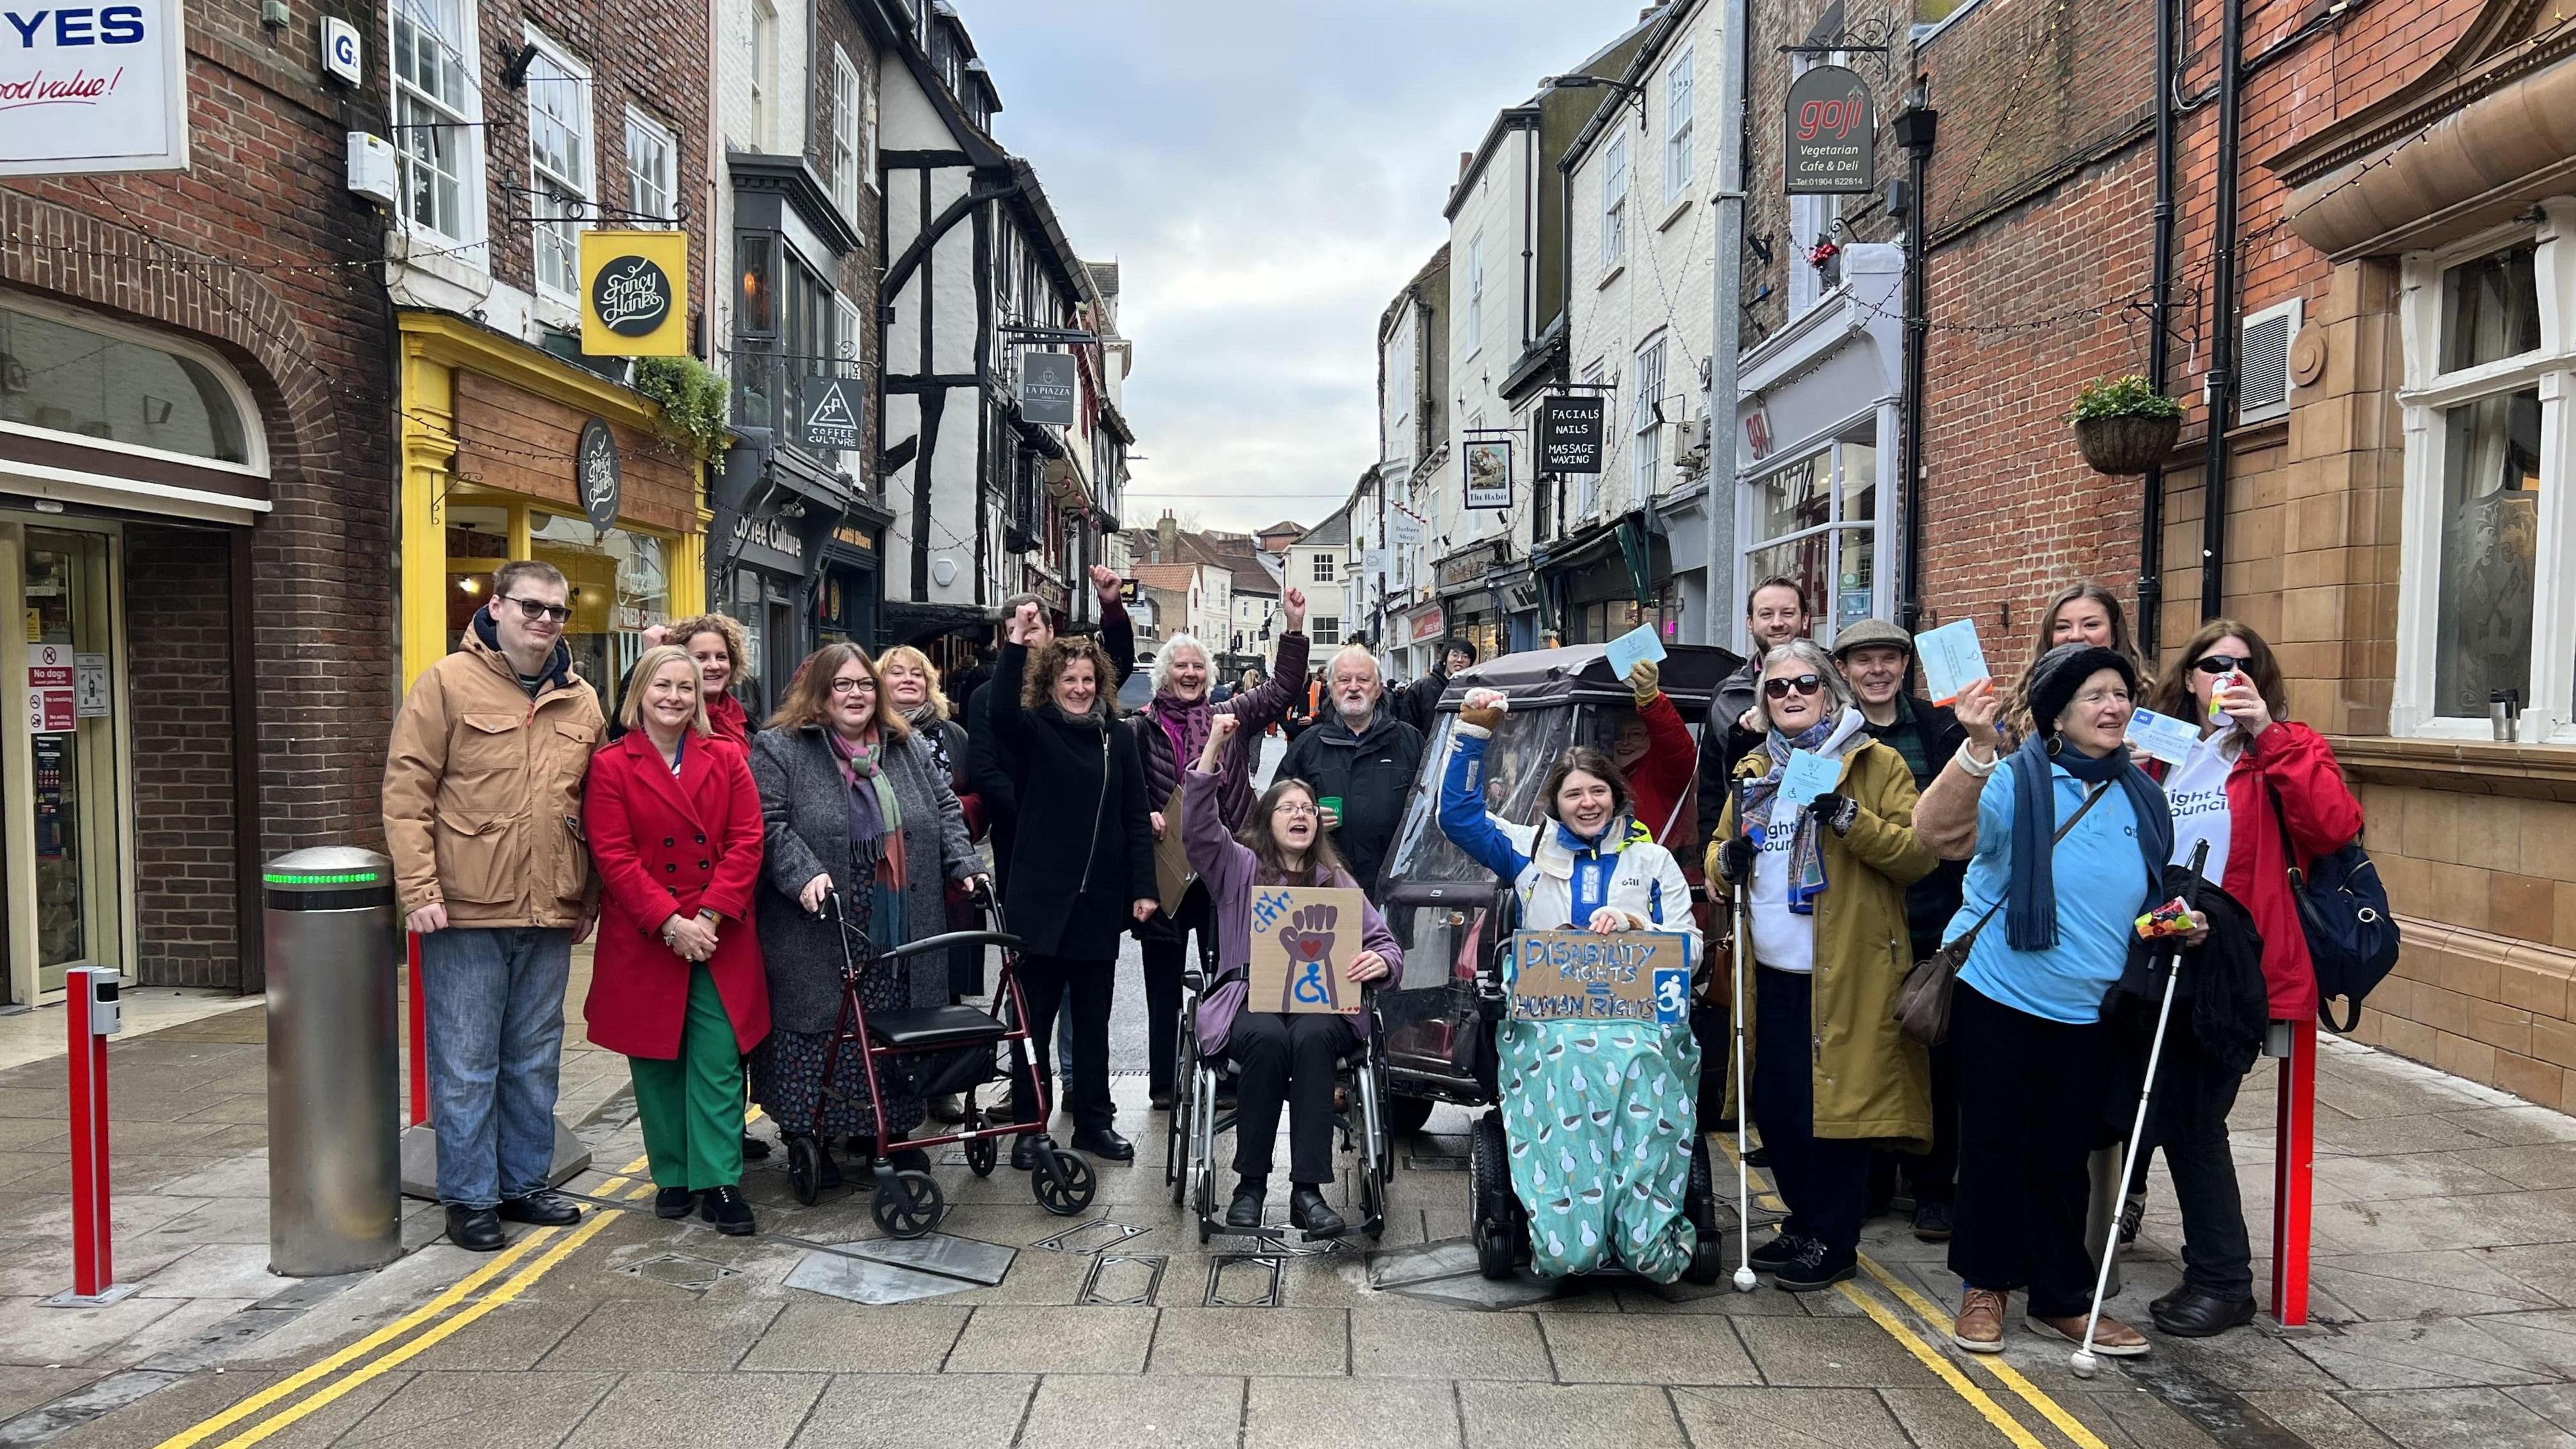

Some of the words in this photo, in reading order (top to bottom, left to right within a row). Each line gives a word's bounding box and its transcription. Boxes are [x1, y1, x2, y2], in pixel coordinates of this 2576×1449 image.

[38, 66, 123, 99] value!
[1796, 91, 1863, 140] goji
[1801, 145, 1858, 158] Vegetarian
[1800, 161, 1824, 172] Cafe
[1827, 161, 1835, 171] &
[1837, 160, 1859, 171] Deli
[604, 268, 656, 300] Fancy
[600, 292, 663, 322] Hanks
[1026, 386, 1037, 394] LA
[1040, 387, 1070, 396] PIAZZA
[1552, 409, 1599, 420] FACIALS
[812, 427, 854, 438] COFFEE
[1556, 425, 1589, 434] NAILS
[808, 435, 857, 447] CULTURE
[1548, 443, 1595, 454] MASSAGE
[1551, 455, 1590, 464] WAXING
[769, 519, 802, 557] Culture
[619, 606, 640, 626] FRIED
[34, 669, 45, 678] No
[47, 669, 66, 680] dogs
[2169, 788, 2212, 806] ight
[2170, 798, 2230, 817] ounci
[1621, 877, 1639, 886] Gill
[1252, 890, 1274, 916] MY
[1253, 890, 1295, 934] CITY!
[1515, 994, 1585, 1017] HUMAN
